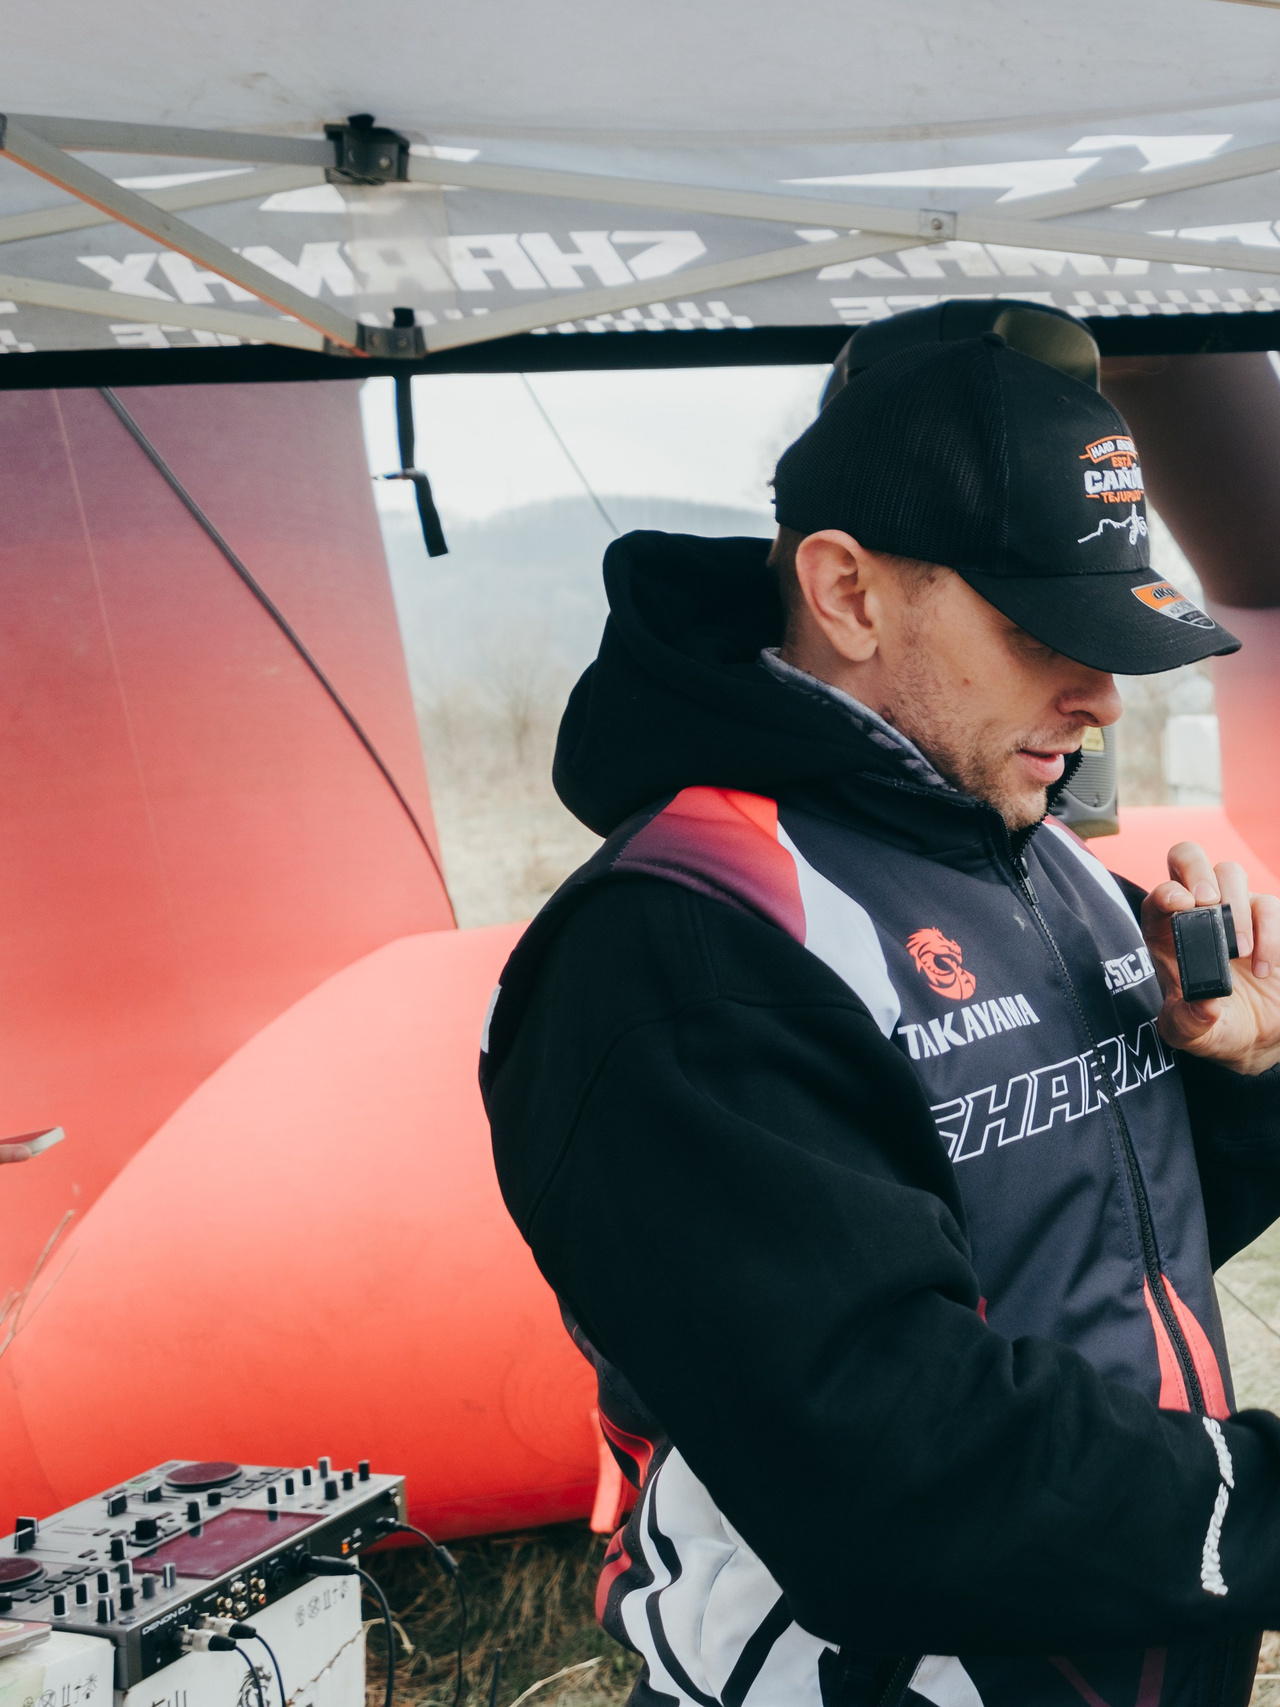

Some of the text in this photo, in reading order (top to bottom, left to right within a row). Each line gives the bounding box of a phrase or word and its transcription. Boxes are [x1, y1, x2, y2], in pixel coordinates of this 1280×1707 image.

[1090, 440, 1115, 459] HARD
[897, 993, 1040, 1060] TAKAYAMA
[930, 1016, 1176, 1163] SHARM
[142, 1602, 192, 1636] DENON DJ
